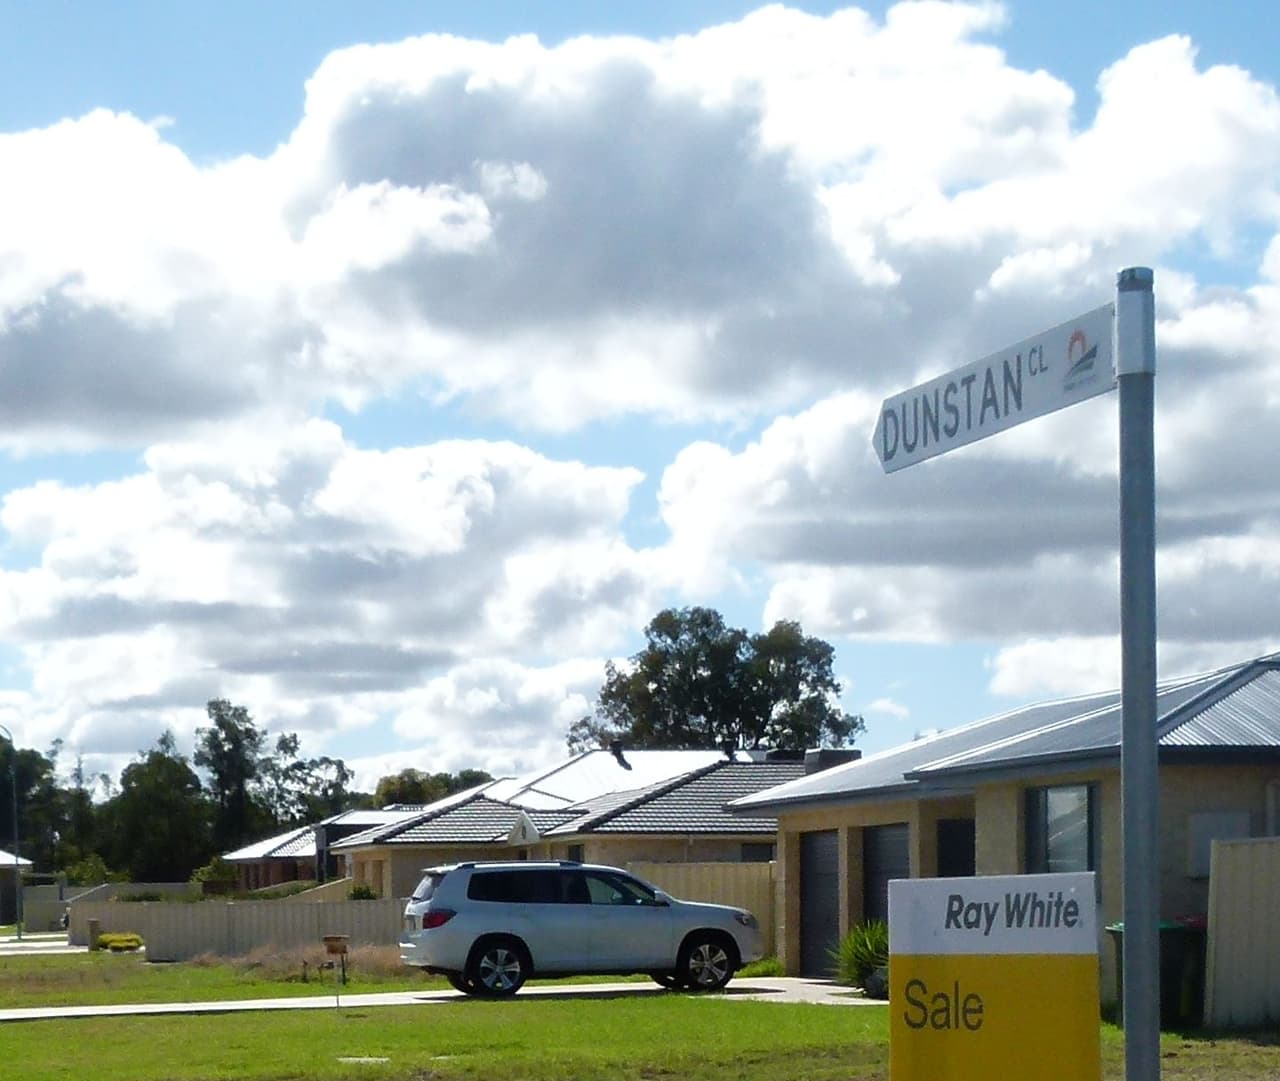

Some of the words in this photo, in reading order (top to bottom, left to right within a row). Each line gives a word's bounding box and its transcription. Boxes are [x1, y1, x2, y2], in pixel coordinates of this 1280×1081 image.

[883, 354, 1023, 462] DUNSTAN
[1028, 345, 1048, 377] CL
[945, 894, 999, 936] Ray
[904, 978, 984, 1031] Sale
